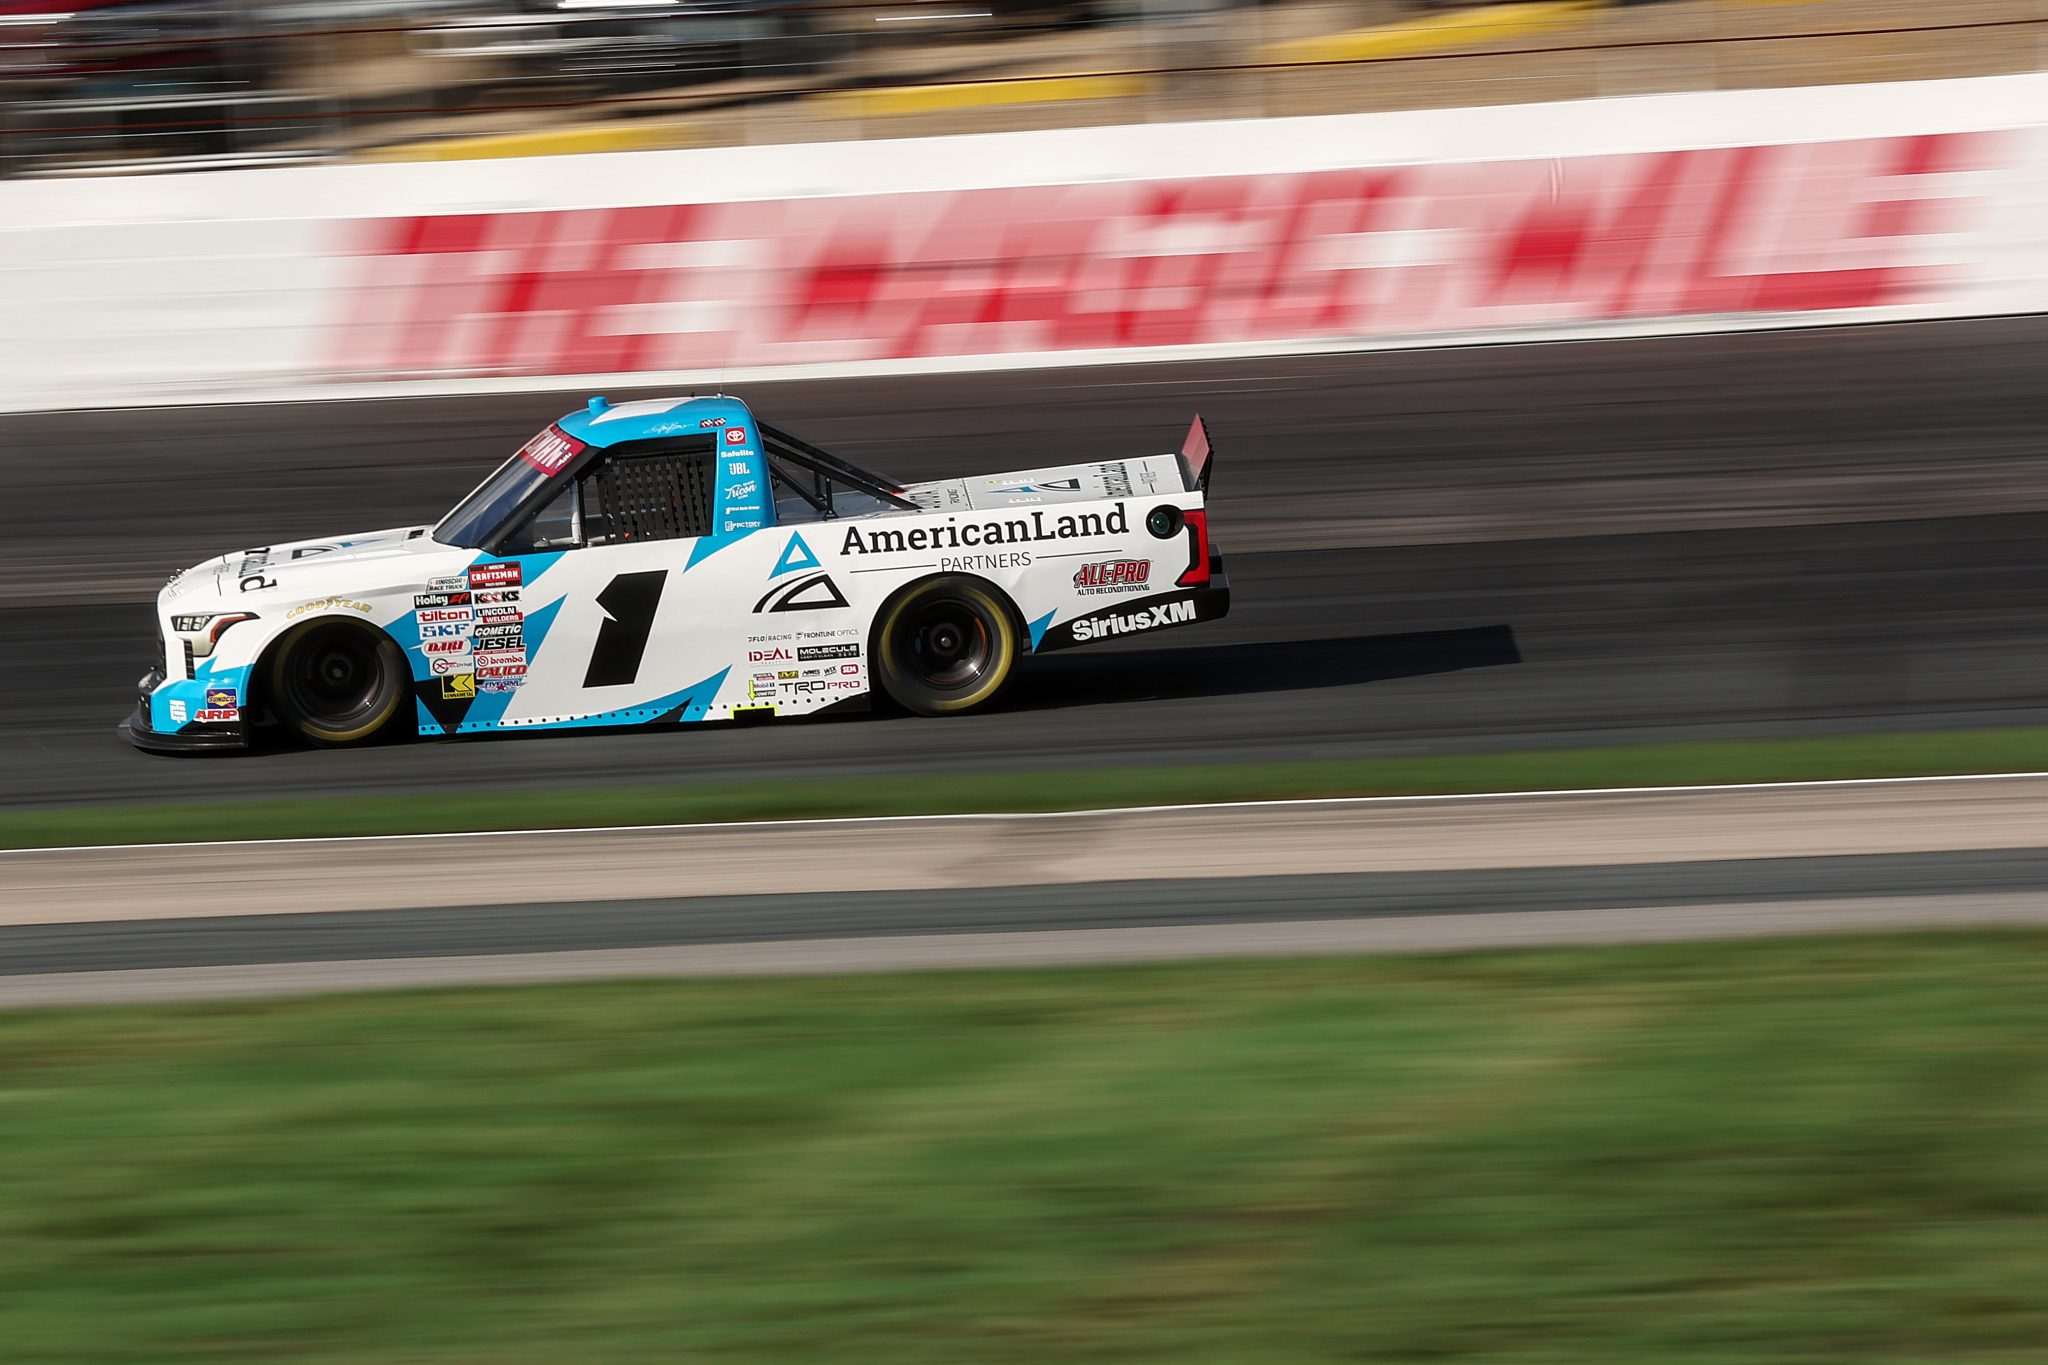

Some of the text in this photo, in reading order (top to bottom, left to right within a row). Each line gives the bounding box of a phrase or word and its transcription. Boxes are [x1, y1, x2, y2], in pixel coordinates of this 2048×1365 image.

[720, 450, 754, 458] Safelite
[729, 462, 750, 475] JBL
[840, 502, 1130, 556] AmericanLand
[941, 552, 1032, 573] PARTNERS
[471, 570, 518, 581] CRAFTSMAN
[1074, 559, 1151, 588] ALL-PRO
[1077, 584, 1150, 596] AUTO RECONDITIONING
[416, 594, 448, 606] Holley
[474, 590, 520, 604] KOOKS
[287, 596, 373, 619] GOODYEAR
[477, 607, 515, 617] LINCOLN
[420, 610, 470, 622] tilton
[1072, 600, 1196, 640] SiriusXM
[422, 624, 469, 638] SKF
[475, 624, 522, 636] COMETIC
[582, 569, 669, 689] 1
[804, 630, 836, 639] FRONTLINE
[474, 637, 525, 650] JESEL
[800, 645, 857, 655] MOLECULE
[490, 655, 522, 664] brembo
[749, 648, 793, 662] IDEAL
[478, 665, 528, 678] CALICO
[842, 665, 858, 674] SEM
[779, 680, 860, 695] TRD PRO
[195, 710, 238, 719] ARP
